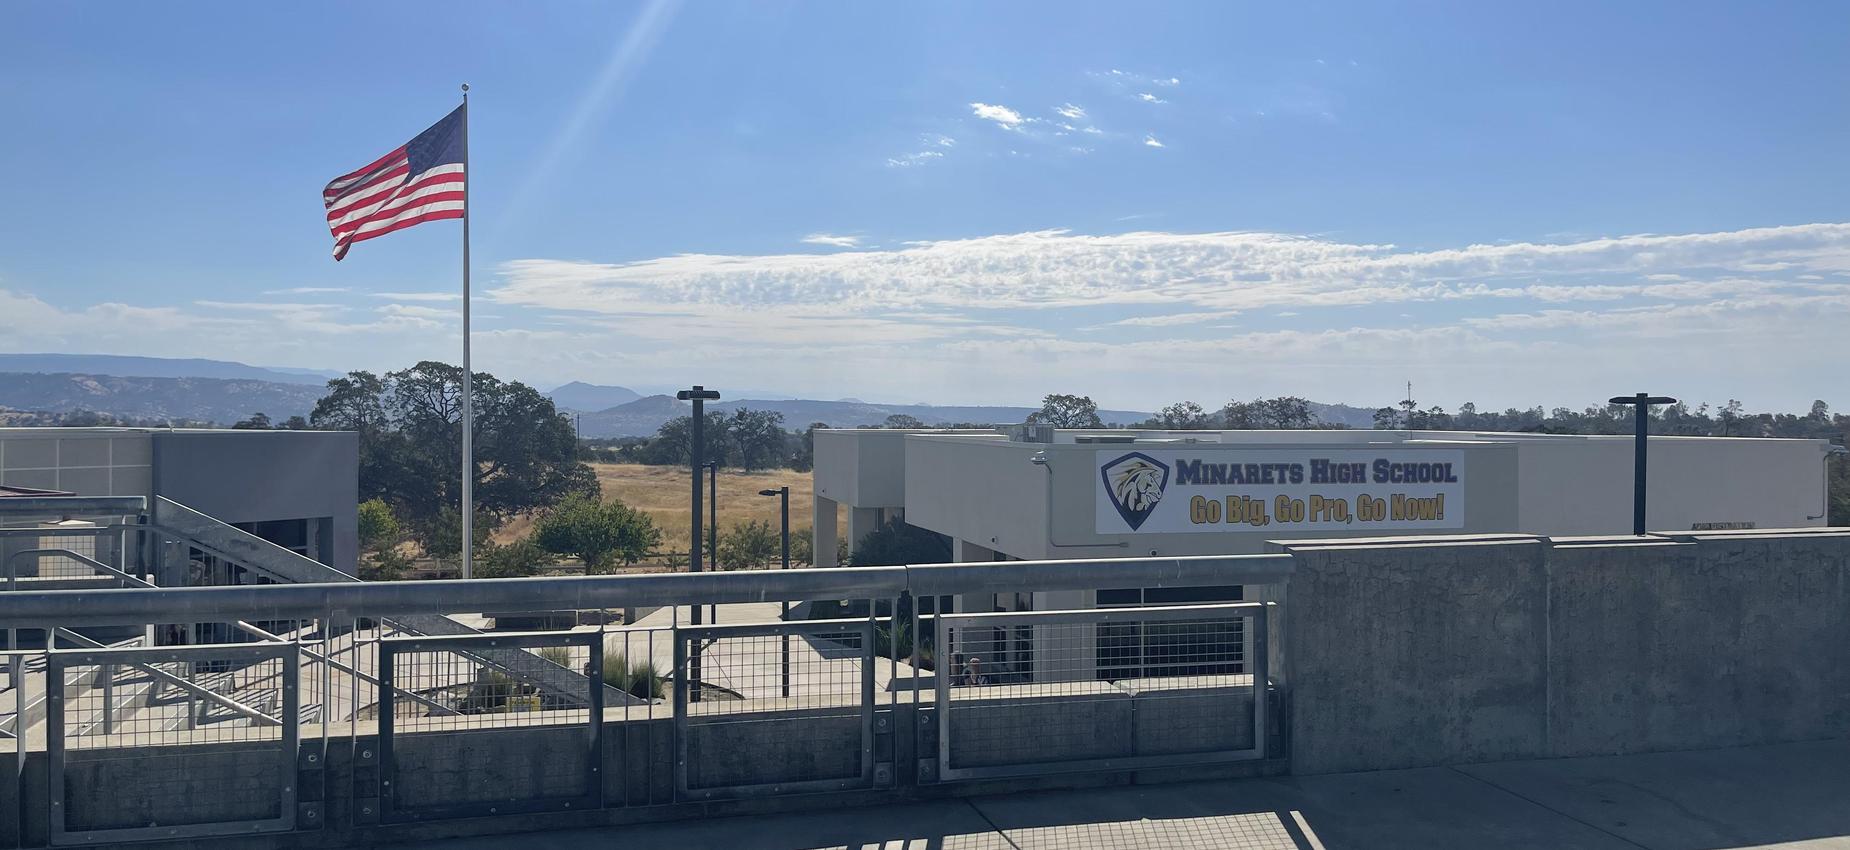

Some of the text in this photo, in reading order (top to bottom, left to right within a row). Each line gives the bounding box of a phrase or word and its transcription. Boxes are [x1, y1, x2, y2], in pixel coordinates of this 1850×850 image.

[1175, 458, 1458, 485] MINARETS HIGH SCHOOL
[1190, 493, 1444, 526] Go Big, Go Pro, Go Now!
